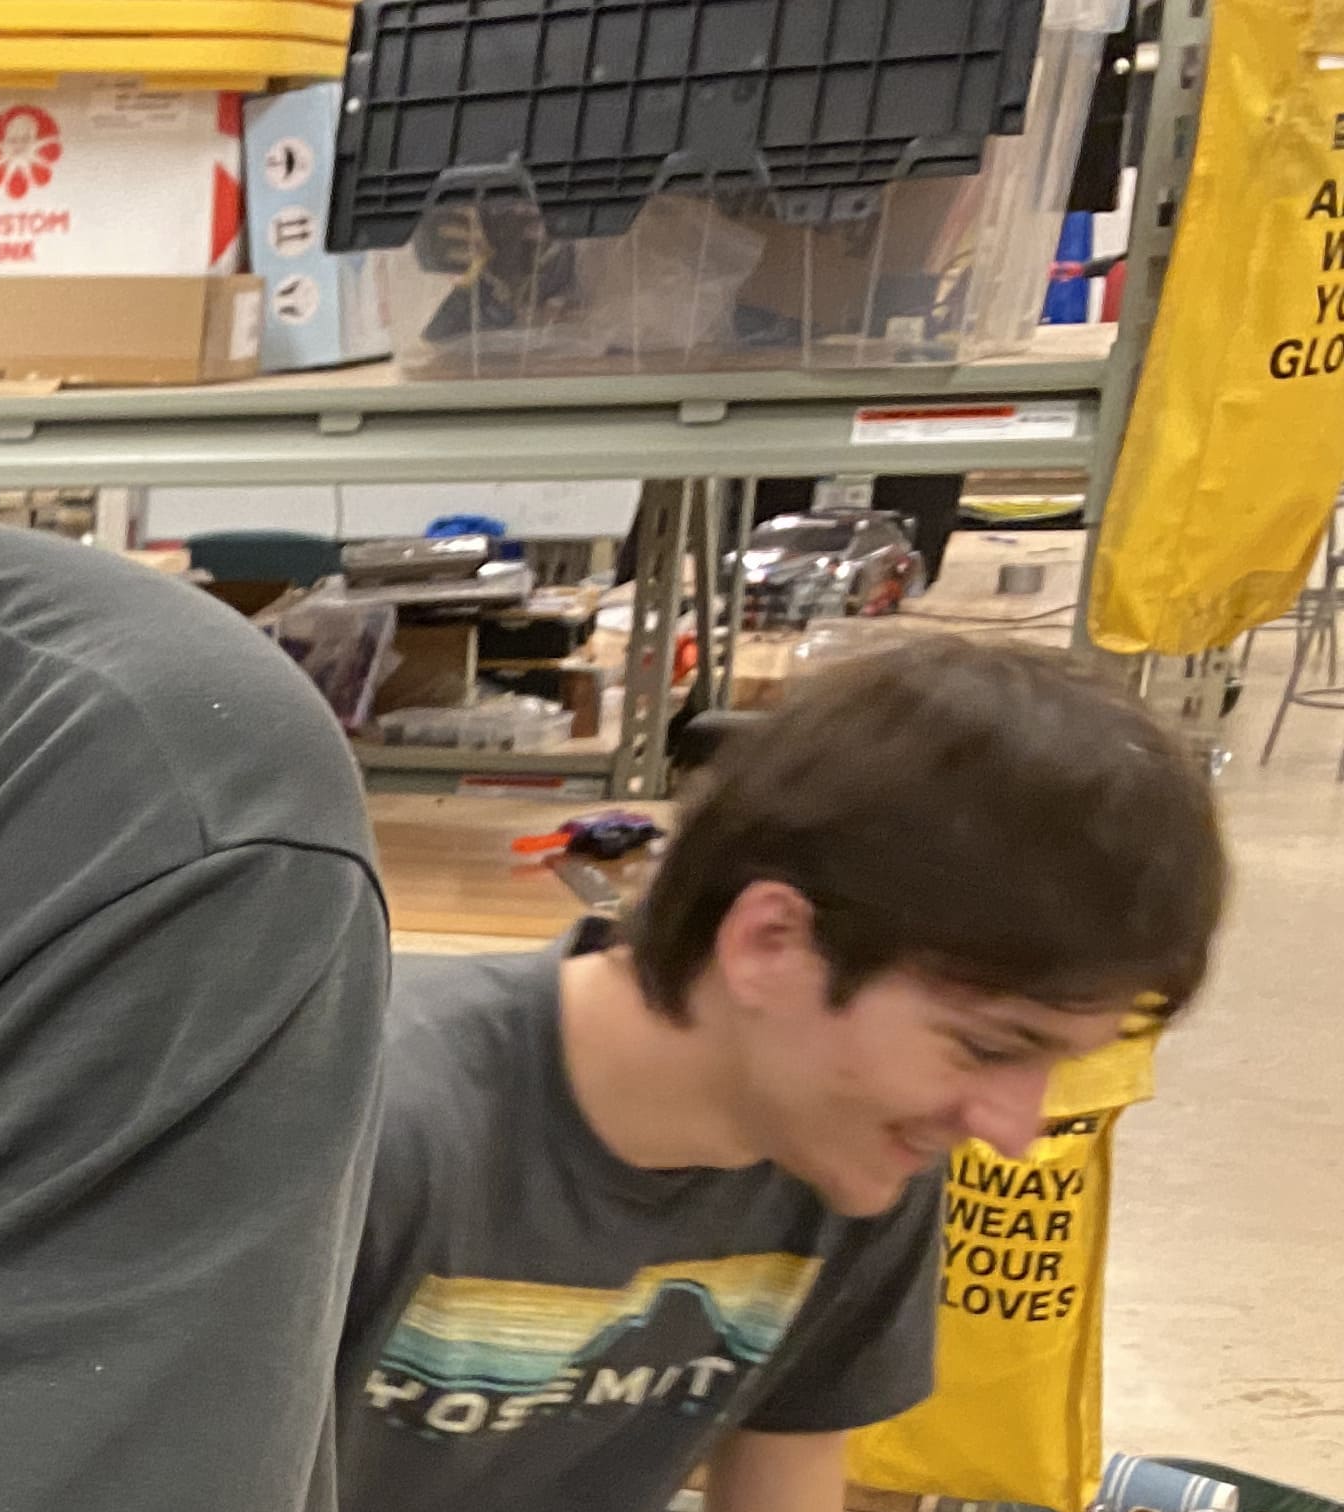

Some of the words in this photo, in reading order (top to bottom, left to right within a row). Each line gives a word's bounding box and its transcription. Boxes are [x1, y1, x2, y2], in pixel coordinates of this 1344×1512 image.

[949, 1155, 1084, 1201] LWAY
[947, 1193, 1072, 1241] WEAR
[943, 1276, 1077, 1322] LOVES
[364, 1356, 752, 1433] YOSEMIT
